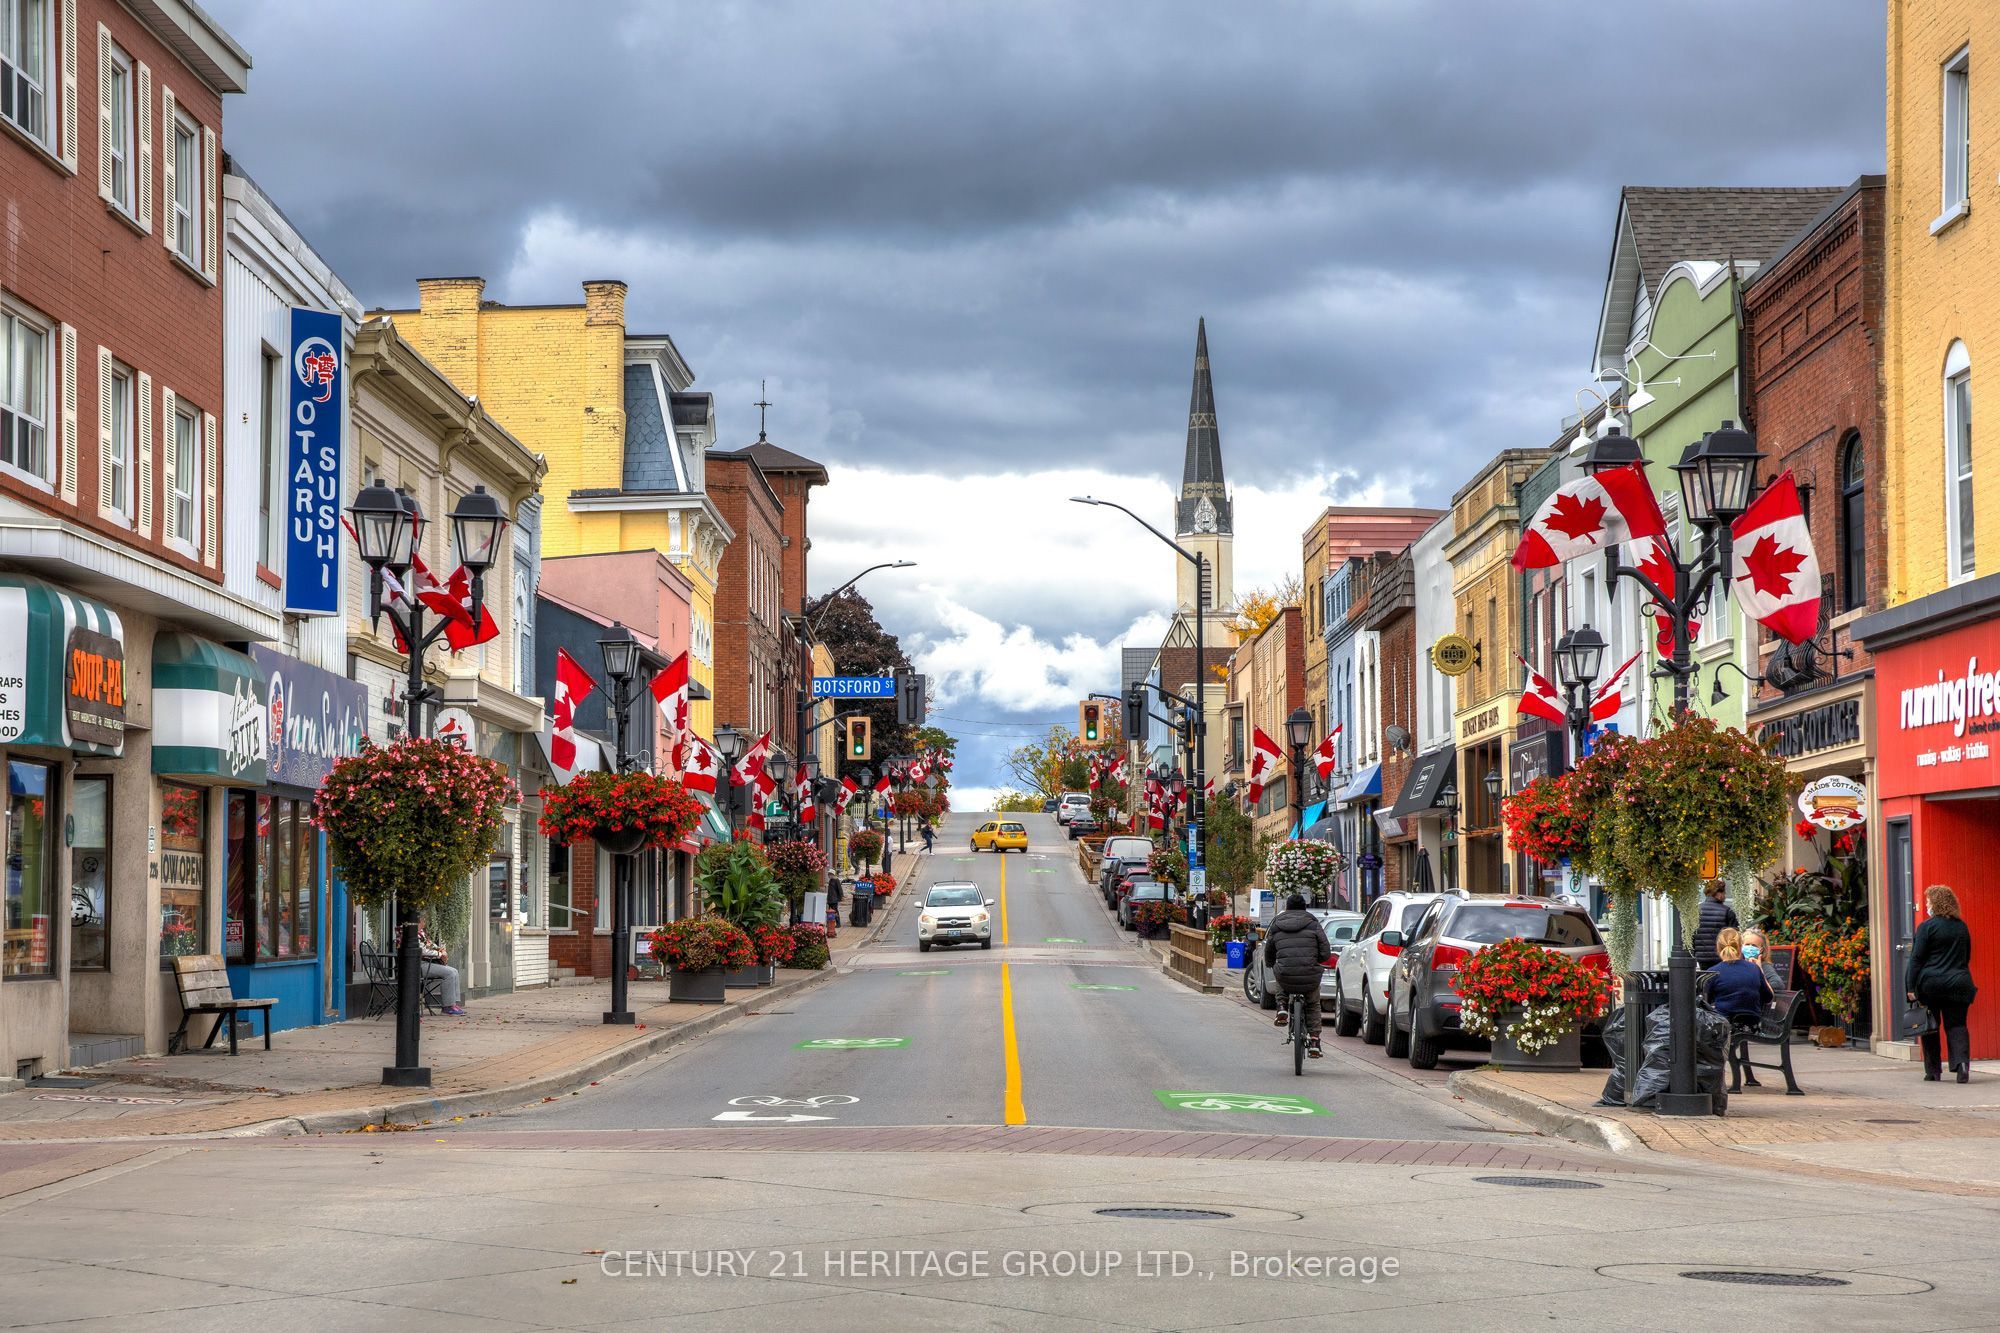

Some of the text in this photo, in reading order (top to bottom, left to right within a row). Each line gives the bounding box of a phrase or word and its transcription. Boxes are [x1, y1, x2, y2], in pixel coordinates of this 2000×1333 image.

[294, 400, 316, 542] OTARU
[316, 447, 336, 588] SUSHI
[813, 680, 894, 694] BOTSFORD ST
[231, 716, 260, 776] FIVE
[1803, 700, 1860, 752] COTTAGE
[1832, 781, 1863, 796] COTTAGE
[180, 855, 202, 886] OPEN
